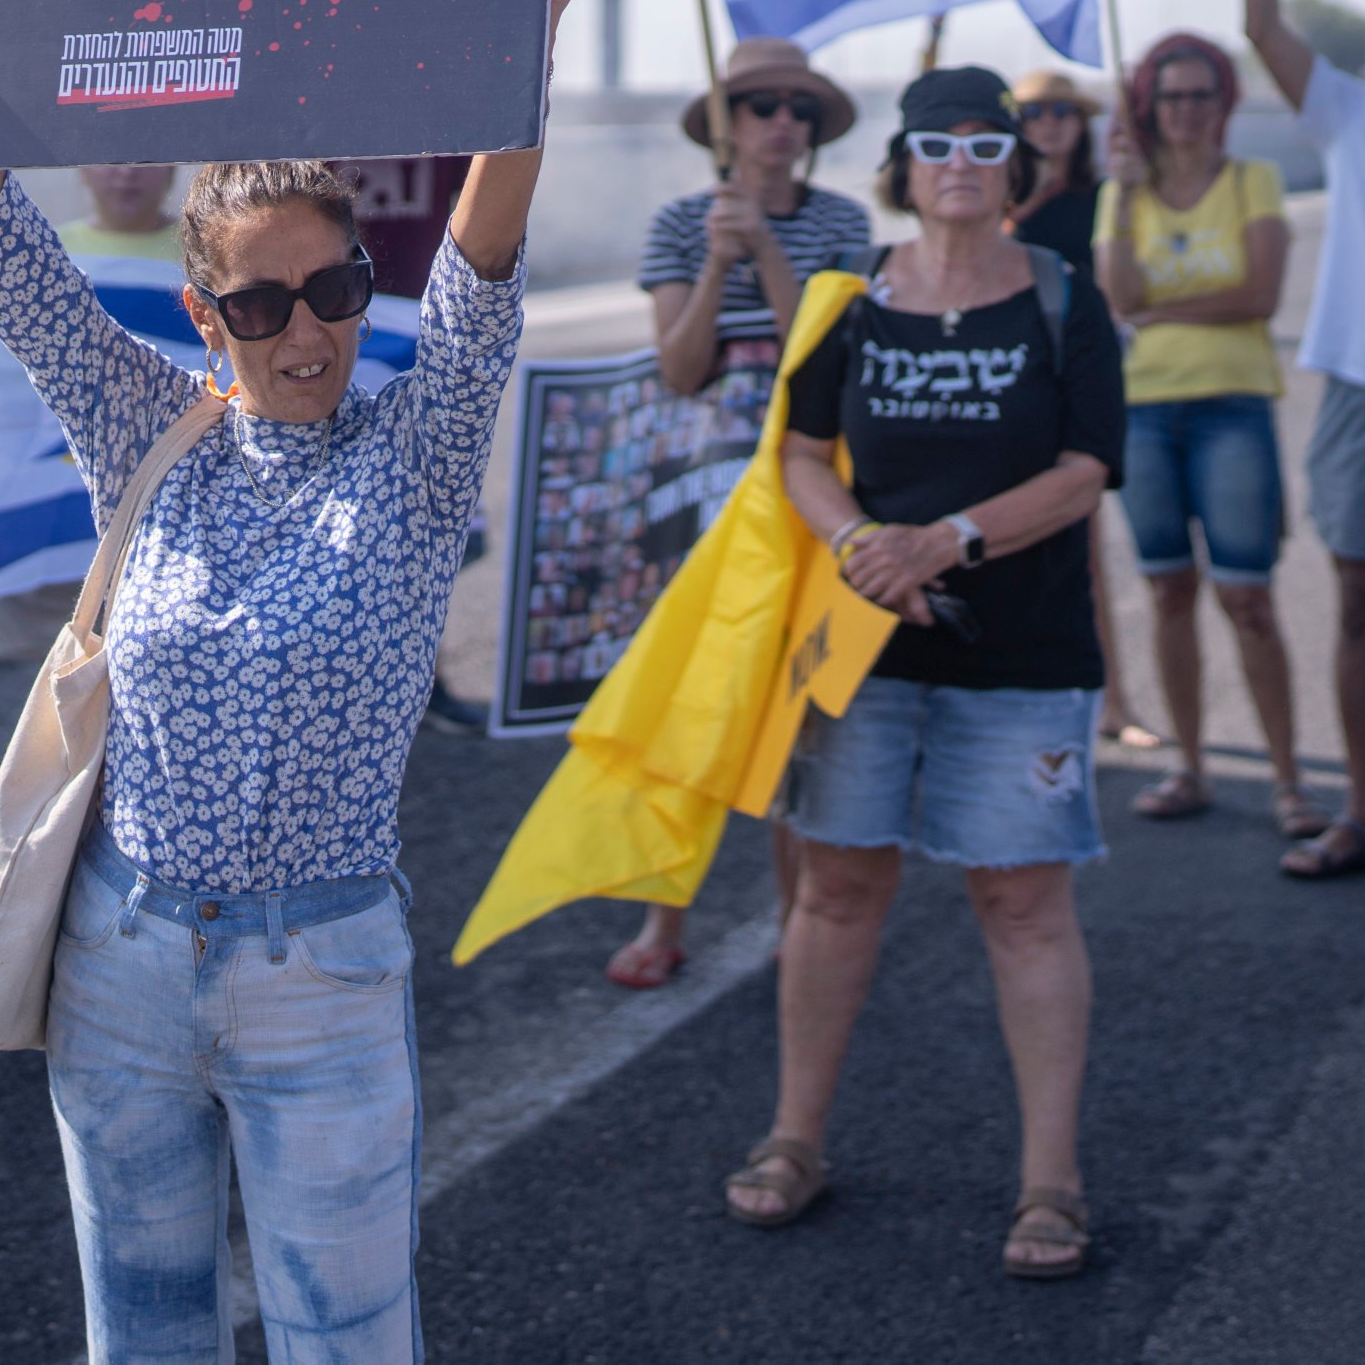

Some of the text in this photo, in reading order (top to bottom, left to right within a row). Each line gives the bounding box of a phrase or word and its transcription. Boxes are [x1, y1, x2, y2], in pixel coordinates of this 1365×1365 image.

[60, 27, 243, 61] מטה המשפחות להחזרת
[58, 56, 242, 98] החטופים והנעדרים
